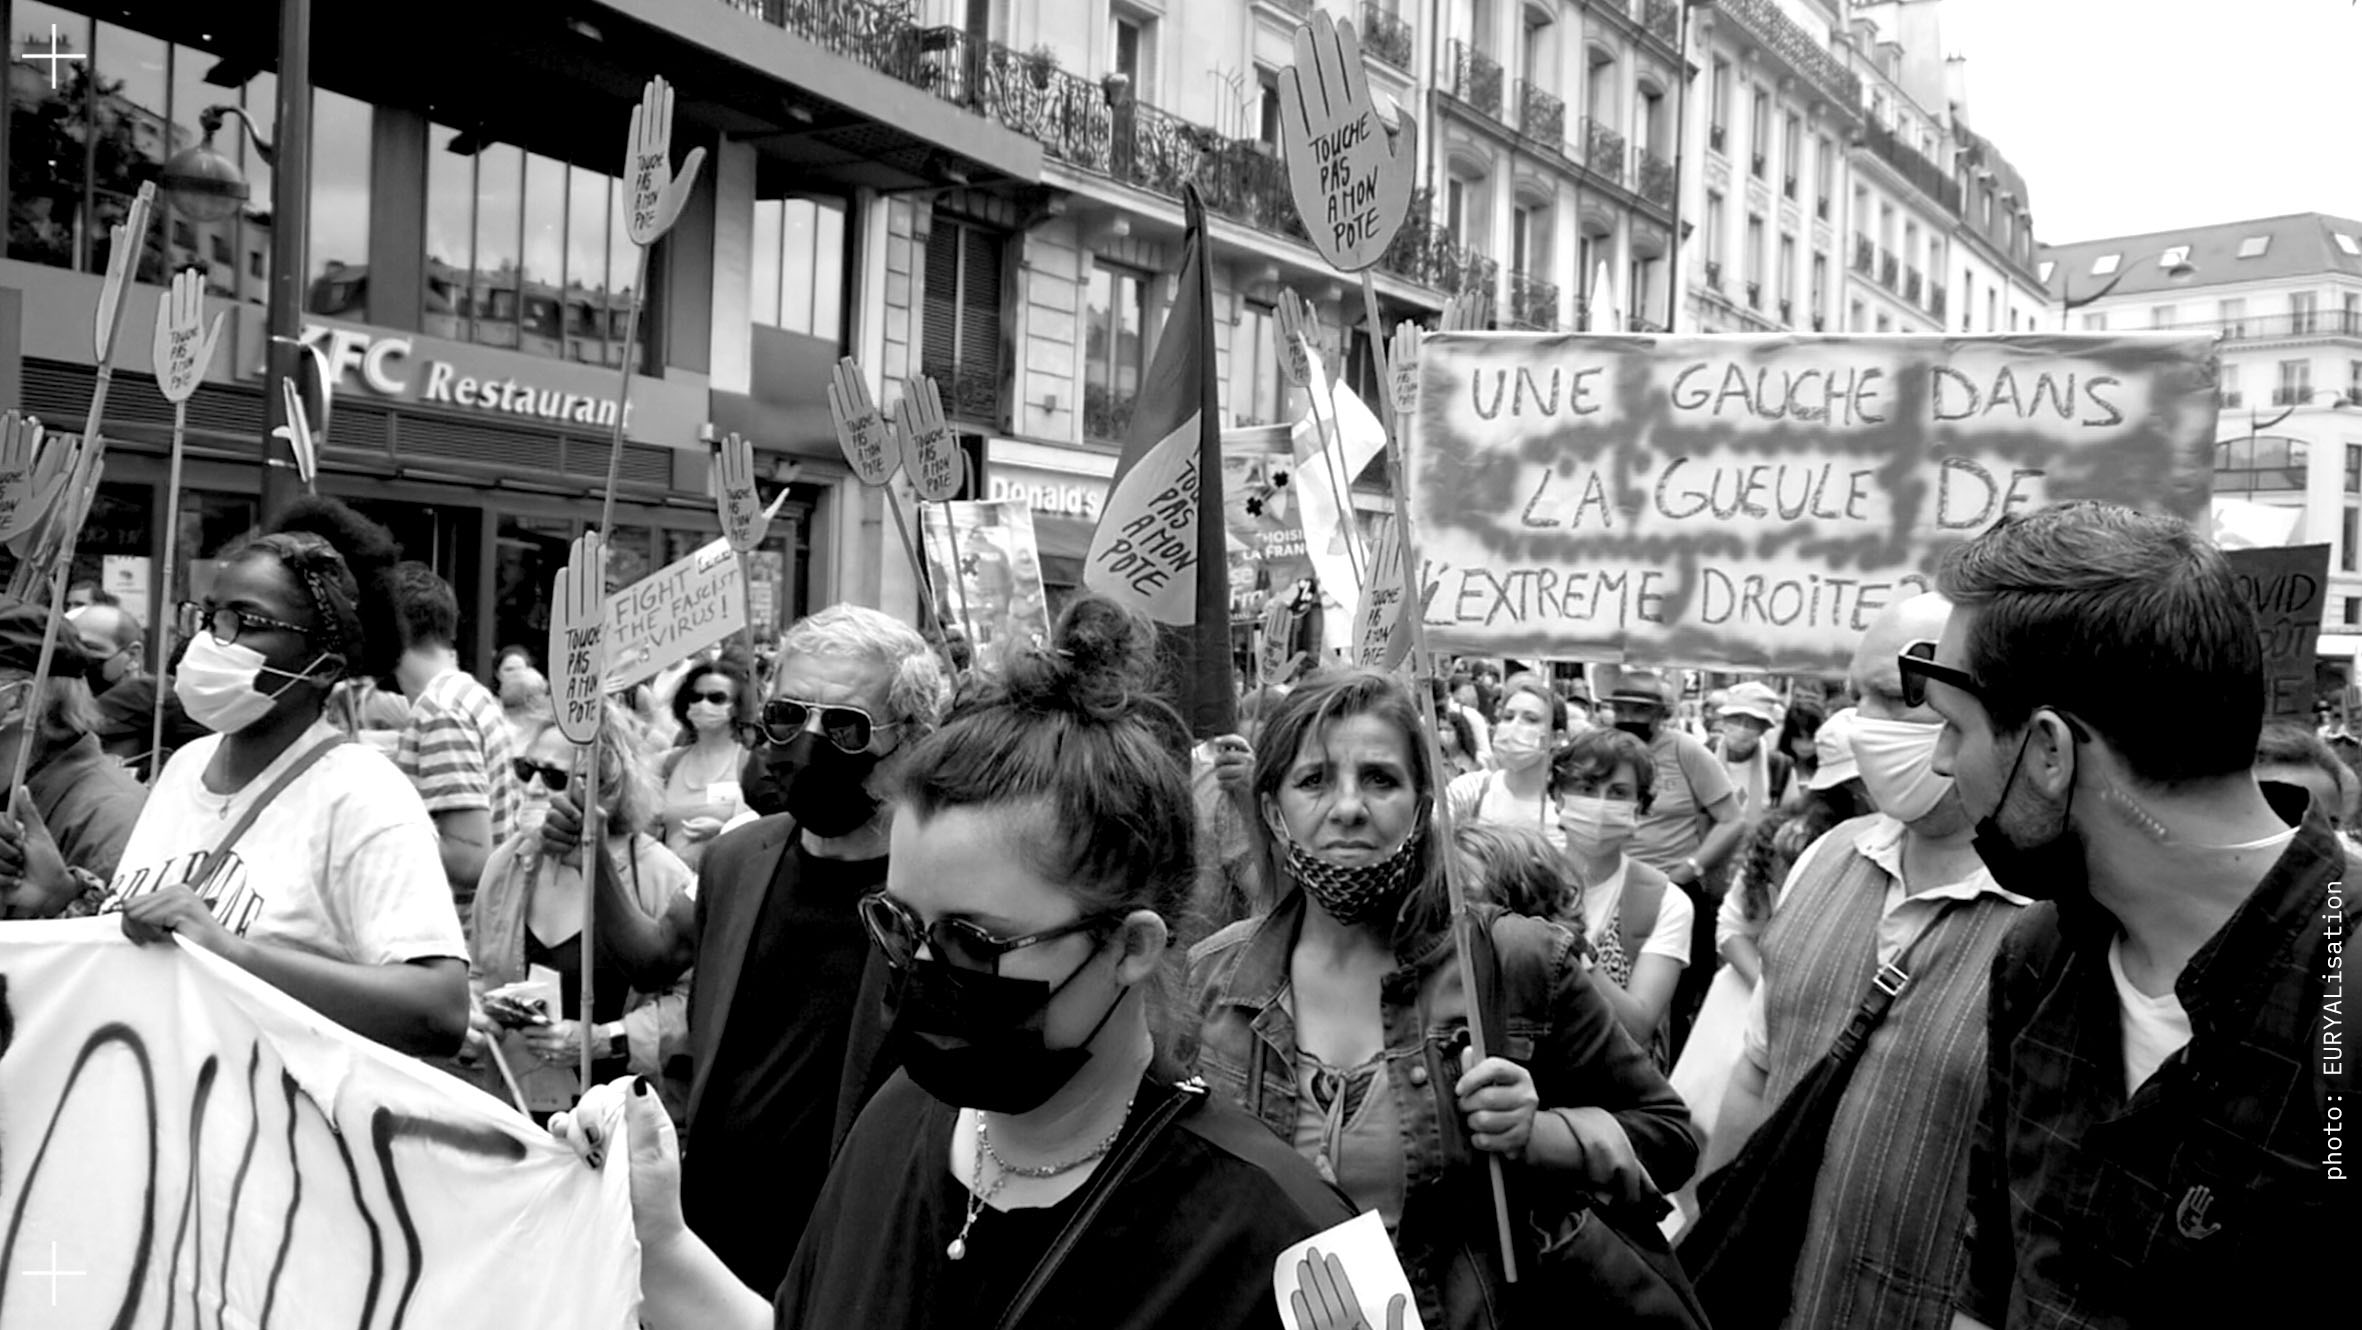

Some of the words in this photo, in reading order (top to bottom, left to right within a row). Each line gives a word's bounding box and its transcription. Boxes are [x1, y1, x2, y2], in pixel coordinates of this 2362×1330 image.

[1308, 112, 1371, 164] TOUCHE
[1320, 156, 1350, 195] PAS
[1328, 194, 1338, 224] A
[1342, 165, 1378, 217] MON
[1333, 207, 1380, 253] POTE
[425, 361, 632, 428] Restaurant
[1472, 366, 1604, 421] UNE
[1671, 362, 1887, 427] GAUCHE
[1929, 365, 2124, 427] DANS
[990, 476, 1097, 515] Donald's
[1148, 488, 1194, 529] PAS
[1521, 468, 1612, 529] LA
[1655, 456, 1874, 521] GUEULE
[1936, 457, 2047, 529] DE
[1096, 539, 1170, 597] POTE
[1122, 515, 1155, 538] A
[1139, 528, 1198, 572] MON
[1421, 560, 1665, 630] L'EXTREME
[614, 606, 661, 642] THE
[566, 677, 576, 699] A
[567, 651, 590, 676] PAS
[567, 698, 596, 723] POTE
